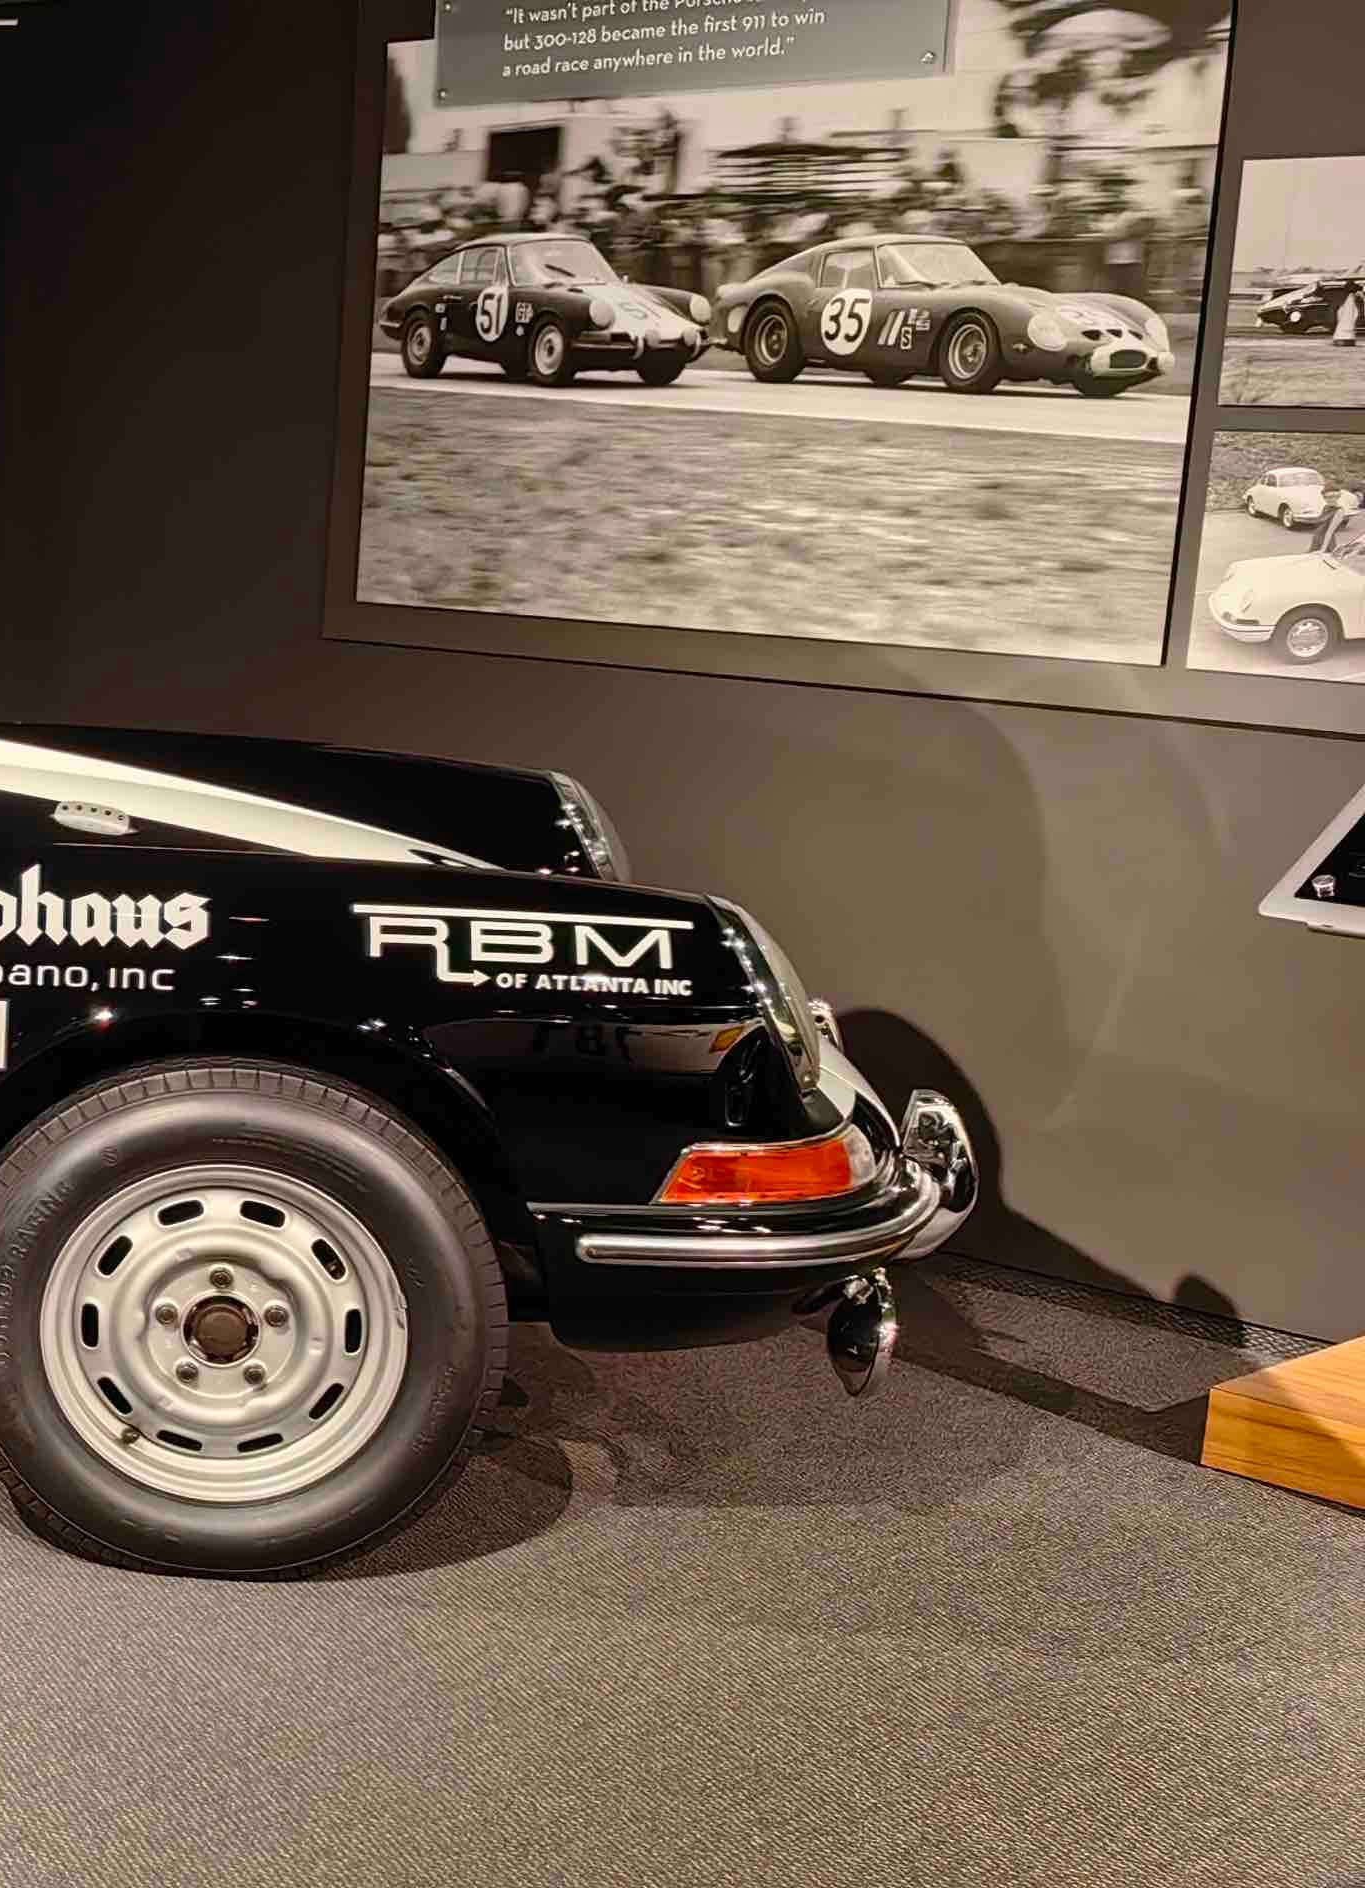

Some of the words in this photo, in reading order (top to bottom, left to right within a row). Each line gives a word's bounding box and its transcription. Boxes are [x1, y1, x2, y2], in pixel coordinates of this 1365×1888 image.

[503, 34, 530, 51] but
[533, 29, 597, 49] 300-128
[601, 26, 666, 43] became
[671, 18, 699, 36] the
[704, 16, 737, 33] first
[742, 15, 765, 32] 911
[771, 11, 790, 27] to
[795, 8, 825, 25] win
[582, 0, 616, 21] part
[620, 0, 638, 14] of
[642, 0, 669, 11] the
[502, 66, 511, 77] a
[515, 56, 551, 76] road
[555, 59, 589, 72] race
[593, 48, 673, 72] anywhere
[678, 46, 693, 63] in
[699, 43, 726, 61] the
[480, 293, 502, 335] 51
[824, 297, 870, 343] 35
[369, 916, 674, 983] RBM
[496, 972, 528, 990] OF
[534, 974, 649, 995] ATLANTA
[654, 978, 693, 997] INC
